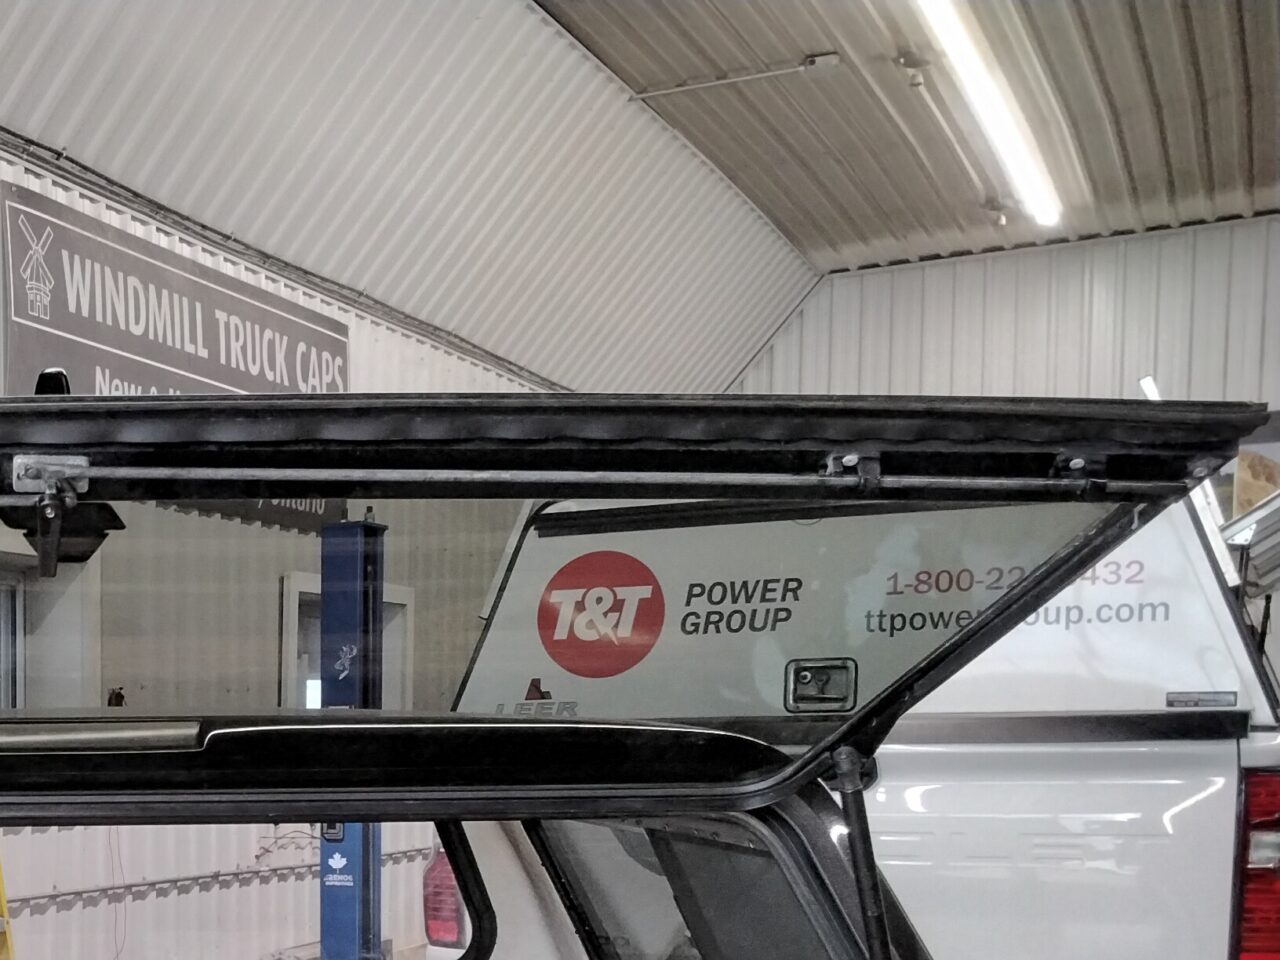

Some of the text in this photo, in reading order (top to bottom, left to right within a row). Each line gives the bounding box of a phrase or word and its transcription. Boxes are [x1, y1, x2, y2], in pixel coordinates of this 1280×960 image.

[61, 248, 344, 394] WINDMILL TRUCK CAPS
[684, 577, 804, 608] POWER
[884, 559, 1146, 597] 1-800-22-432
[549, 584, 654, 647] T&T
[679, 607, 793, 636] GROUP
[494, 700, 579, 718] LEER
